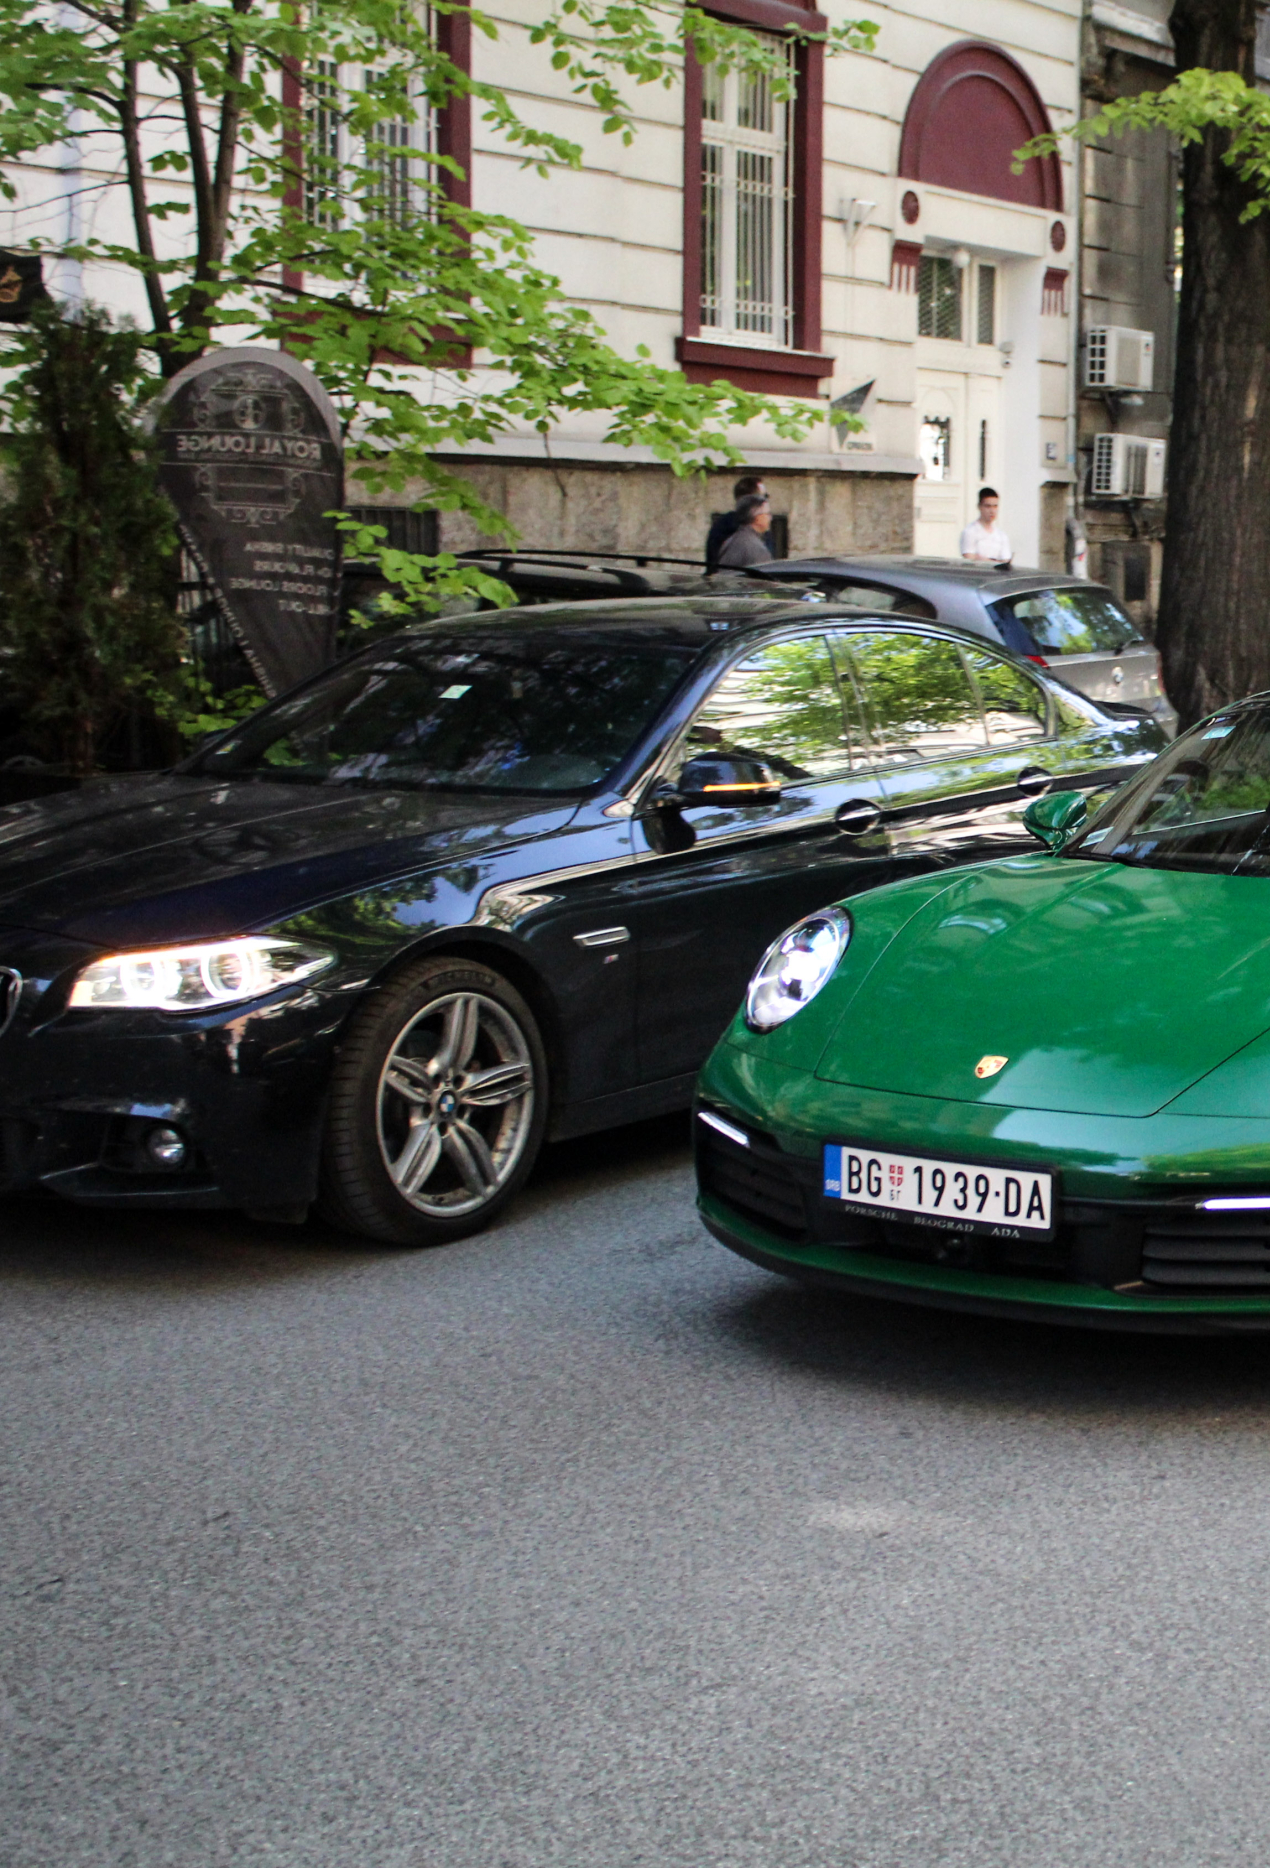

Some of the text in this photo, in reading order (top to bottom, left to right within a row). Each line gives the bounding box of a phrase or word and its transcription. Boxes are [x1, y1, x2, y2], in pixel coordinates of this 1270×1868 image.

[848, 1154, 882, 1198] BG
[845, 1204, 1021, 1239] PORSCHE BEOGRAD ADA
